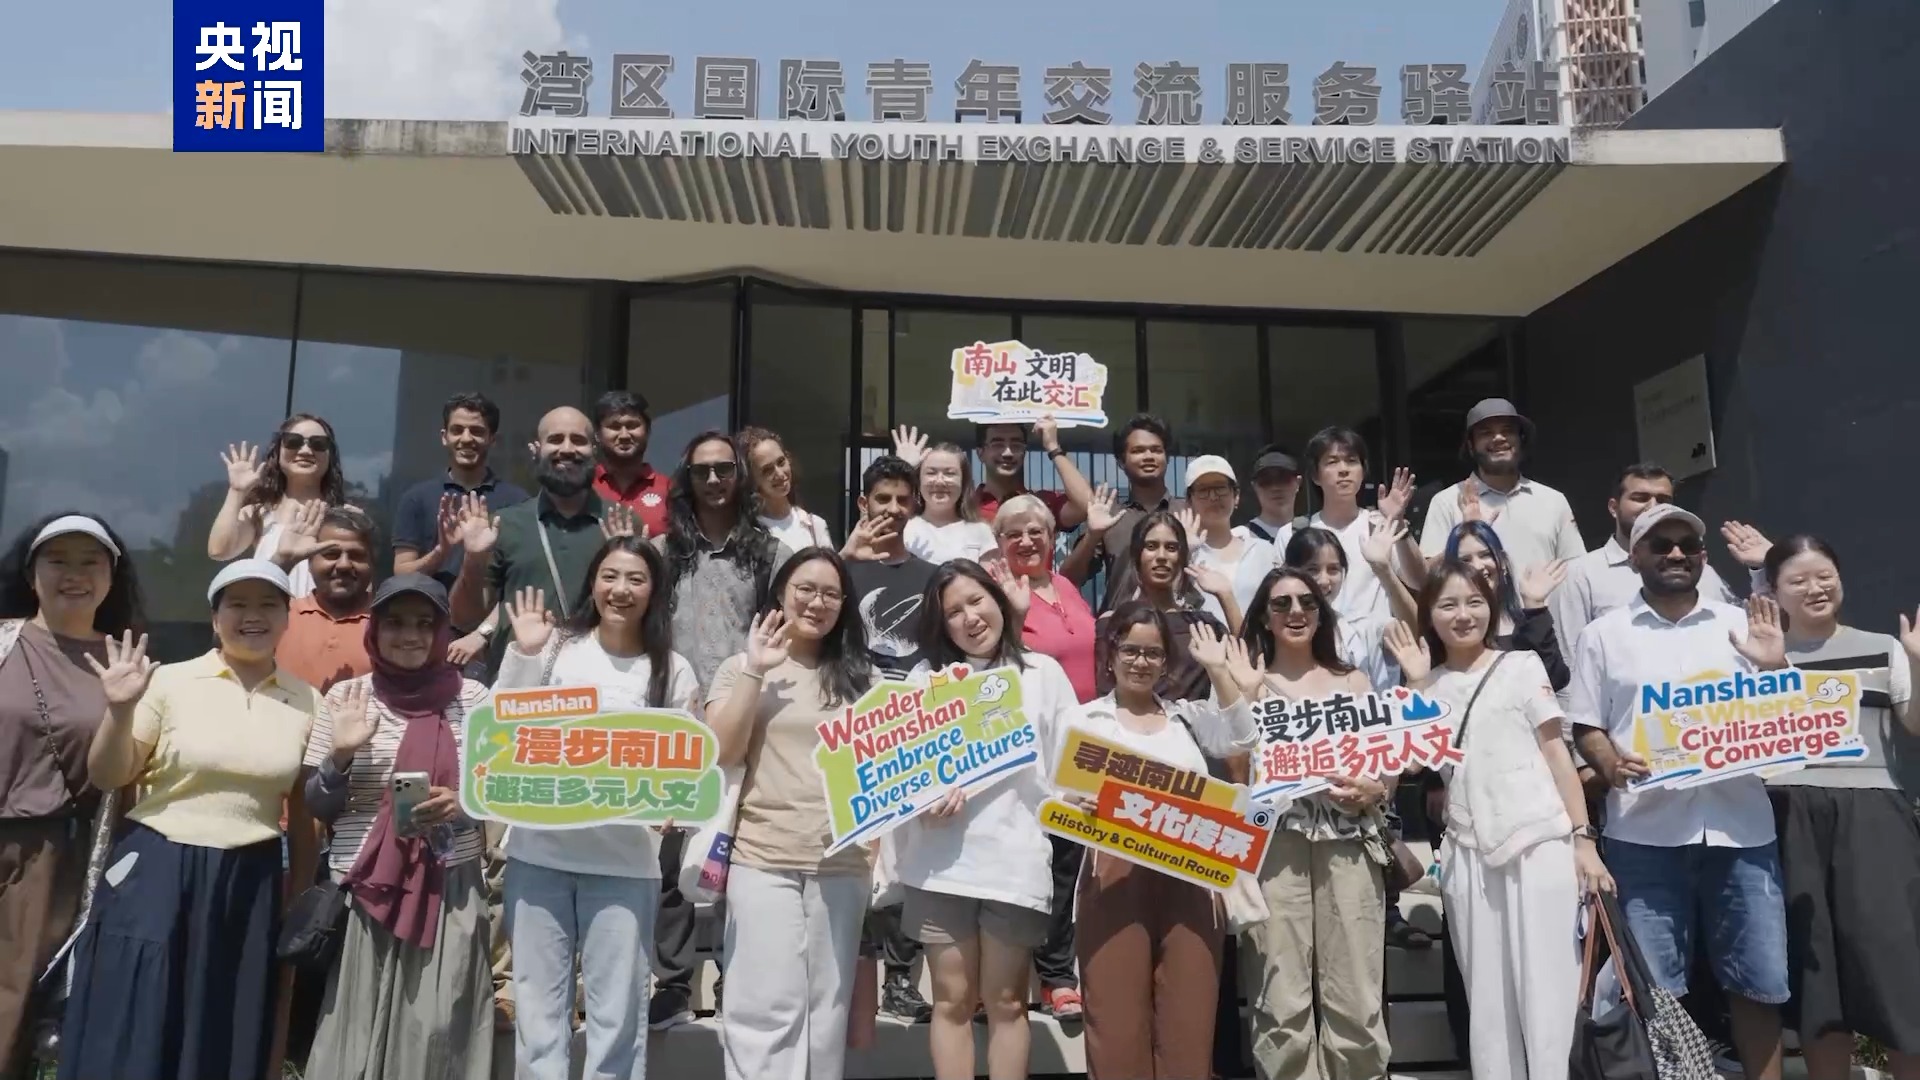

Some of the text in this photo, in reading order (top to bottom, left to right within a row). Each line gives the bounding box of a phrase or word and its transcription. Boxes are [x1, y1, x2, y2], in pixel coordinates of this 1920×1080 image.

[519, 49, 1562, 126] 湾区国际青年交流服务驿站
[511, 127, 1572, 165] INTERNATIONAL YOUTH EXCHANGE & SERVICE STATION
[964, 344, 1077, 382] 南山 文明
[992, 376, 1090, 407] 在此交汇
[500, 693, 592, 717] Nanshan
[1642, 670, 1802, 714] Nanshan
[1705, 694, 1807, 725] Where
[818, 689, 925, 752] Wander
[853, 698, 966, 764] Nanshan
[1252, 693, 1393, 744] 漫步南山
[1681, 710, 1847, 751] Civilizations
[512, 725, 703, 770] 漫步南山
[857, 727, 964, 794] Embrace
[1263, 724, 1465, 784] 邂逅多元人文
[484, 775, 700, 810] 邂逅多元人文
[850, 724, 1036, 825] Diverse Cultures
[1049, 810, 1230, 884] History & Cultural Route
